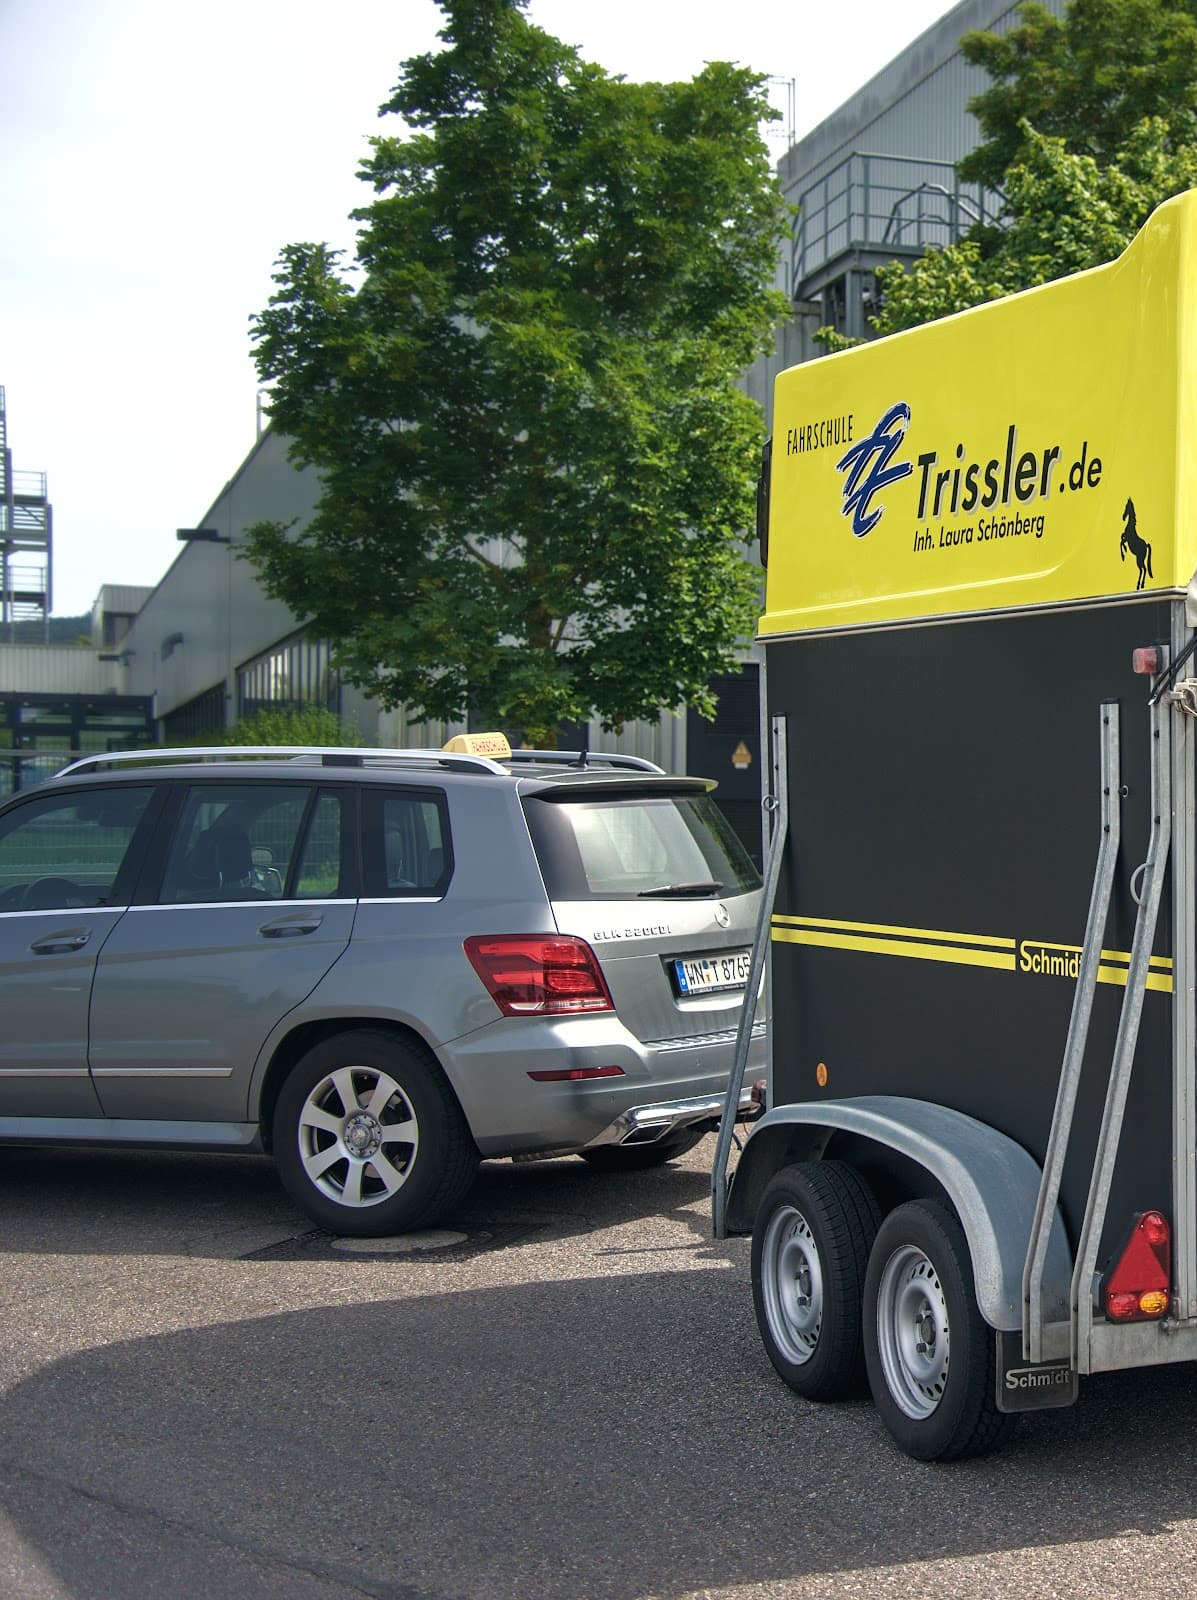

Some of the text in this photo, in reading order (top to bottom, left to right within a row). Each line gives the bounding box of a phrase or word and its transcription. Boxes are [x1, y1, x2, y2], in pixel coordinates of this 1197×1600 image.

[786, 413, 854, 456] FAHRSCHULE
[916, 424, 1102, 519] Trissler.de
[913, 513, 1045, 553] Inh. Laura Schönberg
[685, 961, 706, 986] WN
[709, 960, 719, 982] T
[1020, 939, 1084, 978] Schmid
[1006, 1364, 1071, 1390] Schmidt
